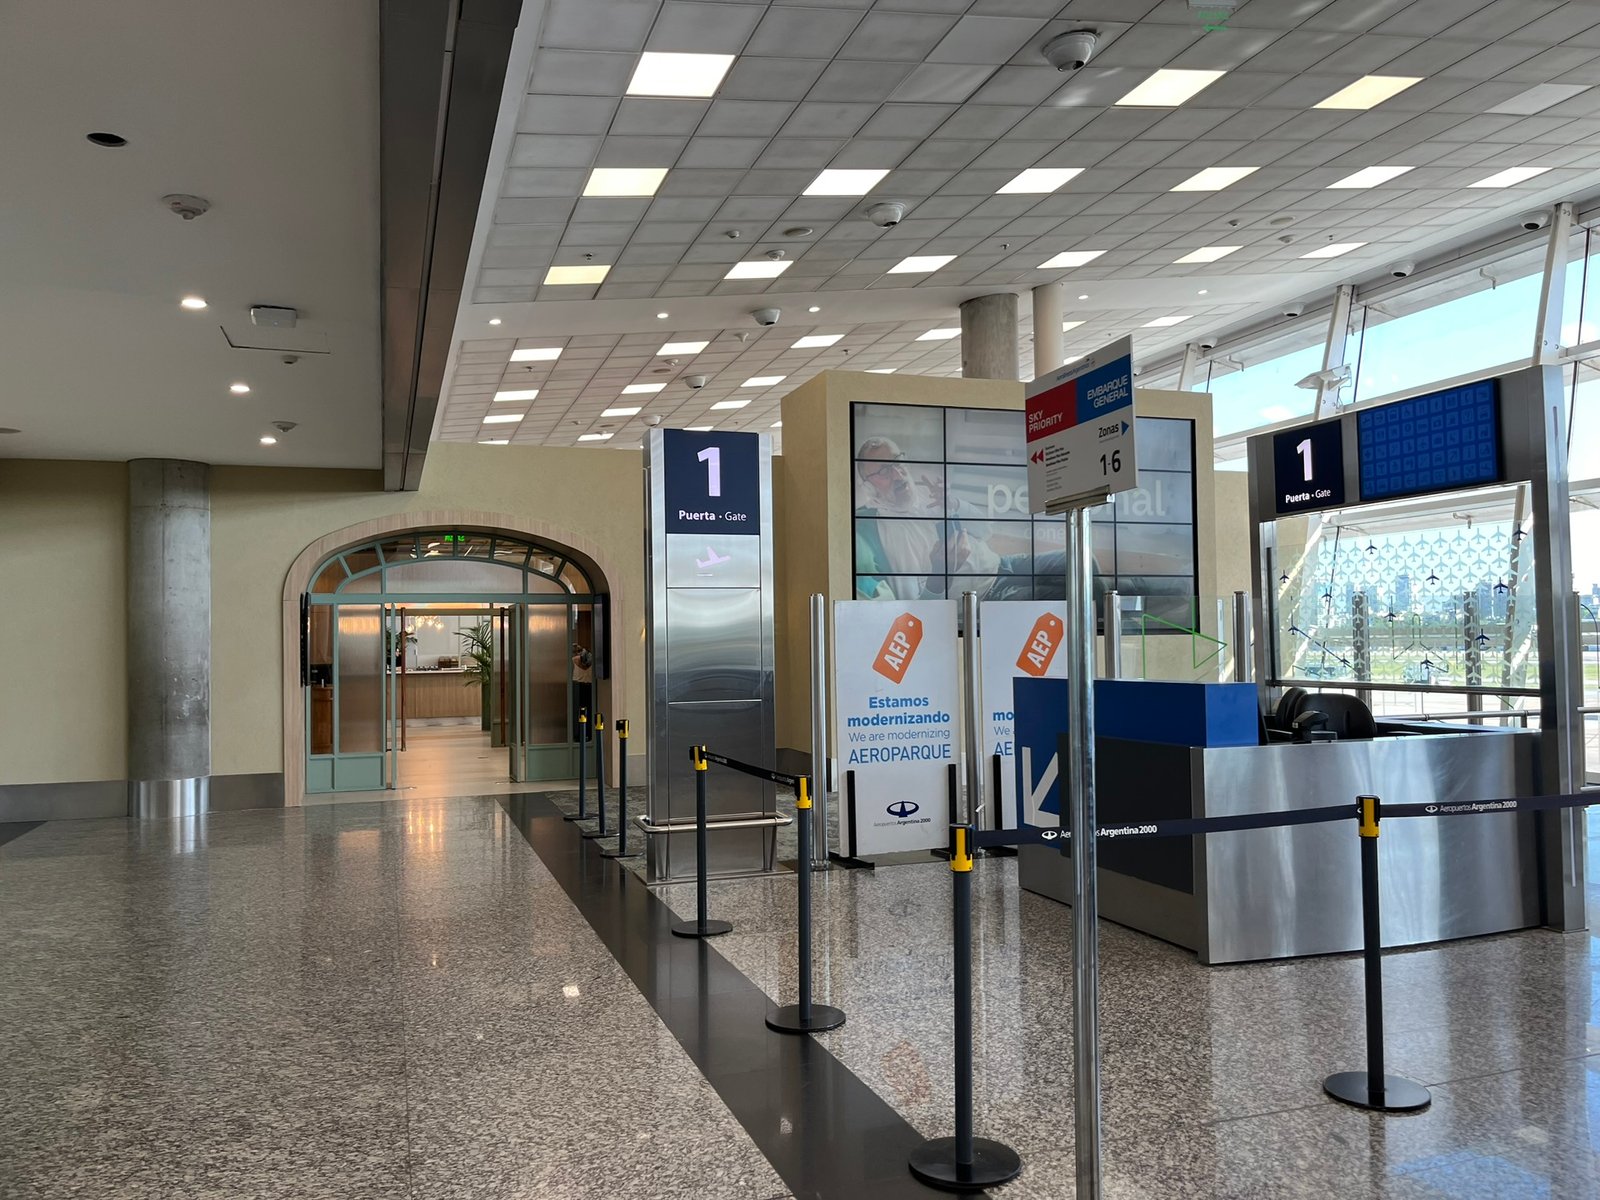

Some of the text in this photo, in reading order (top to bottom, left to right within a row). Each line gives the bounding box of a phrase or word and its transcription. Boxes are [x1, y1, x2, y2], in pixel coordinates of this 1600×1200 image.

[1087, 374, 1129, 400] EMBARQUE
[1094, 387, 1129, 409] GENERAL
[1028, 410, 1044, 423] SKY
[1028, 412, 1063, 434] PRIORITY
[1098, 423, 1119, 438] Zonas
[1296, 438, 1313, 481] 1
[696, 446, 721, 497] 1
[1285, 489, 1331, 504] Puerta Gate
[678, 510, 747, 521] Puerta Gate
[883, 631, 911, 672] AEP
[1026, 630, 1052, 669] AEP
[869, 696, 929, 709] Estamos
[847, 711, 950, 727] modernizando
[848, 729, 951, 742] We are modernizing
[993, 726, 1011, 736] We
[848, 743, 952, 765] AEROPARQUE
[1440, 800, 1518, 813] Aeropuertos Argentina 2000
[1100, 826, 1139, 838] Argentina
[1139, 824, 1158, 834] 2000
